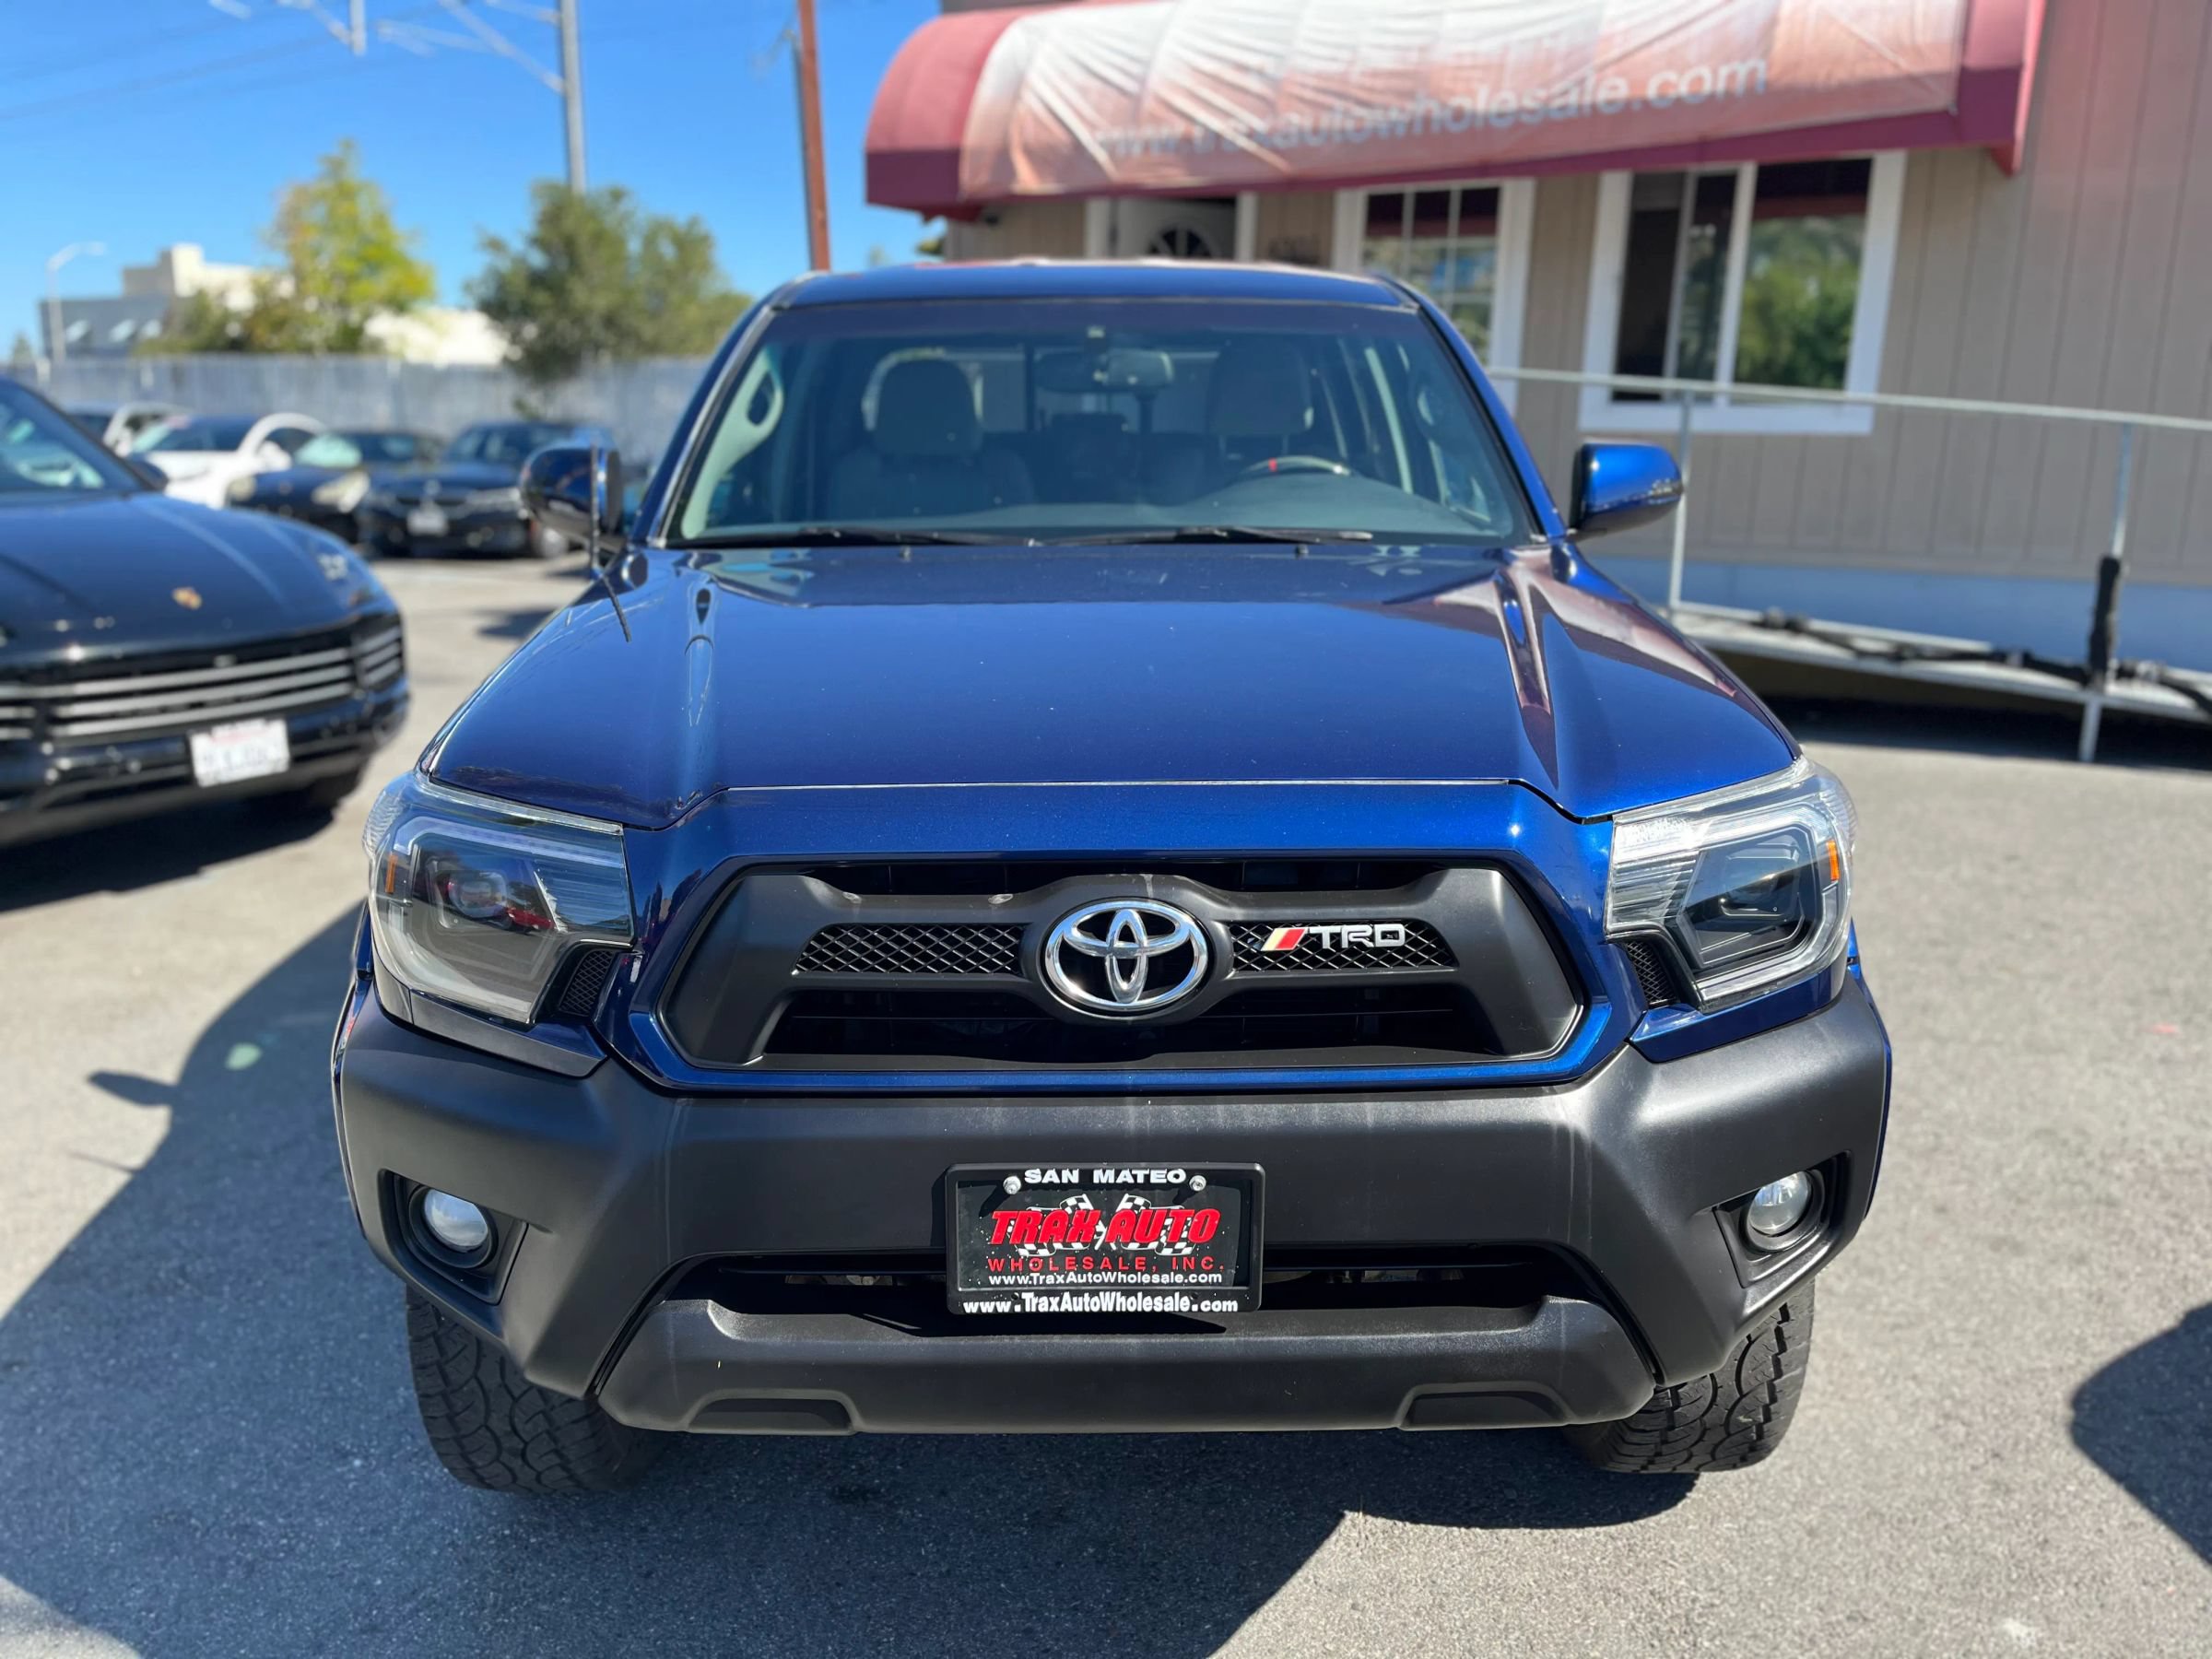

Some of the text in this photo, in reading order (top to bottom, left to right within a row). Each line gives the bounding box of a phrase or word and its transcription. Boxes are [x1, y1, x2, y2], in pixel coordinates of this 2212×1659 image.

[1309, 924, 1406, 949] TRD
[1024, 1169, 1186, 1183] SAN MATEO
[990, 1208, 1222, 1244] TRAX AUTO
[988, 1256, 1224, 1272] WHOLESALE, INC.
[988, 1272, 1223, 1285] www.TraxAutoWholesale.com
[963, 1292, 1239, 1313] www.TraxAutoWholesale.com
